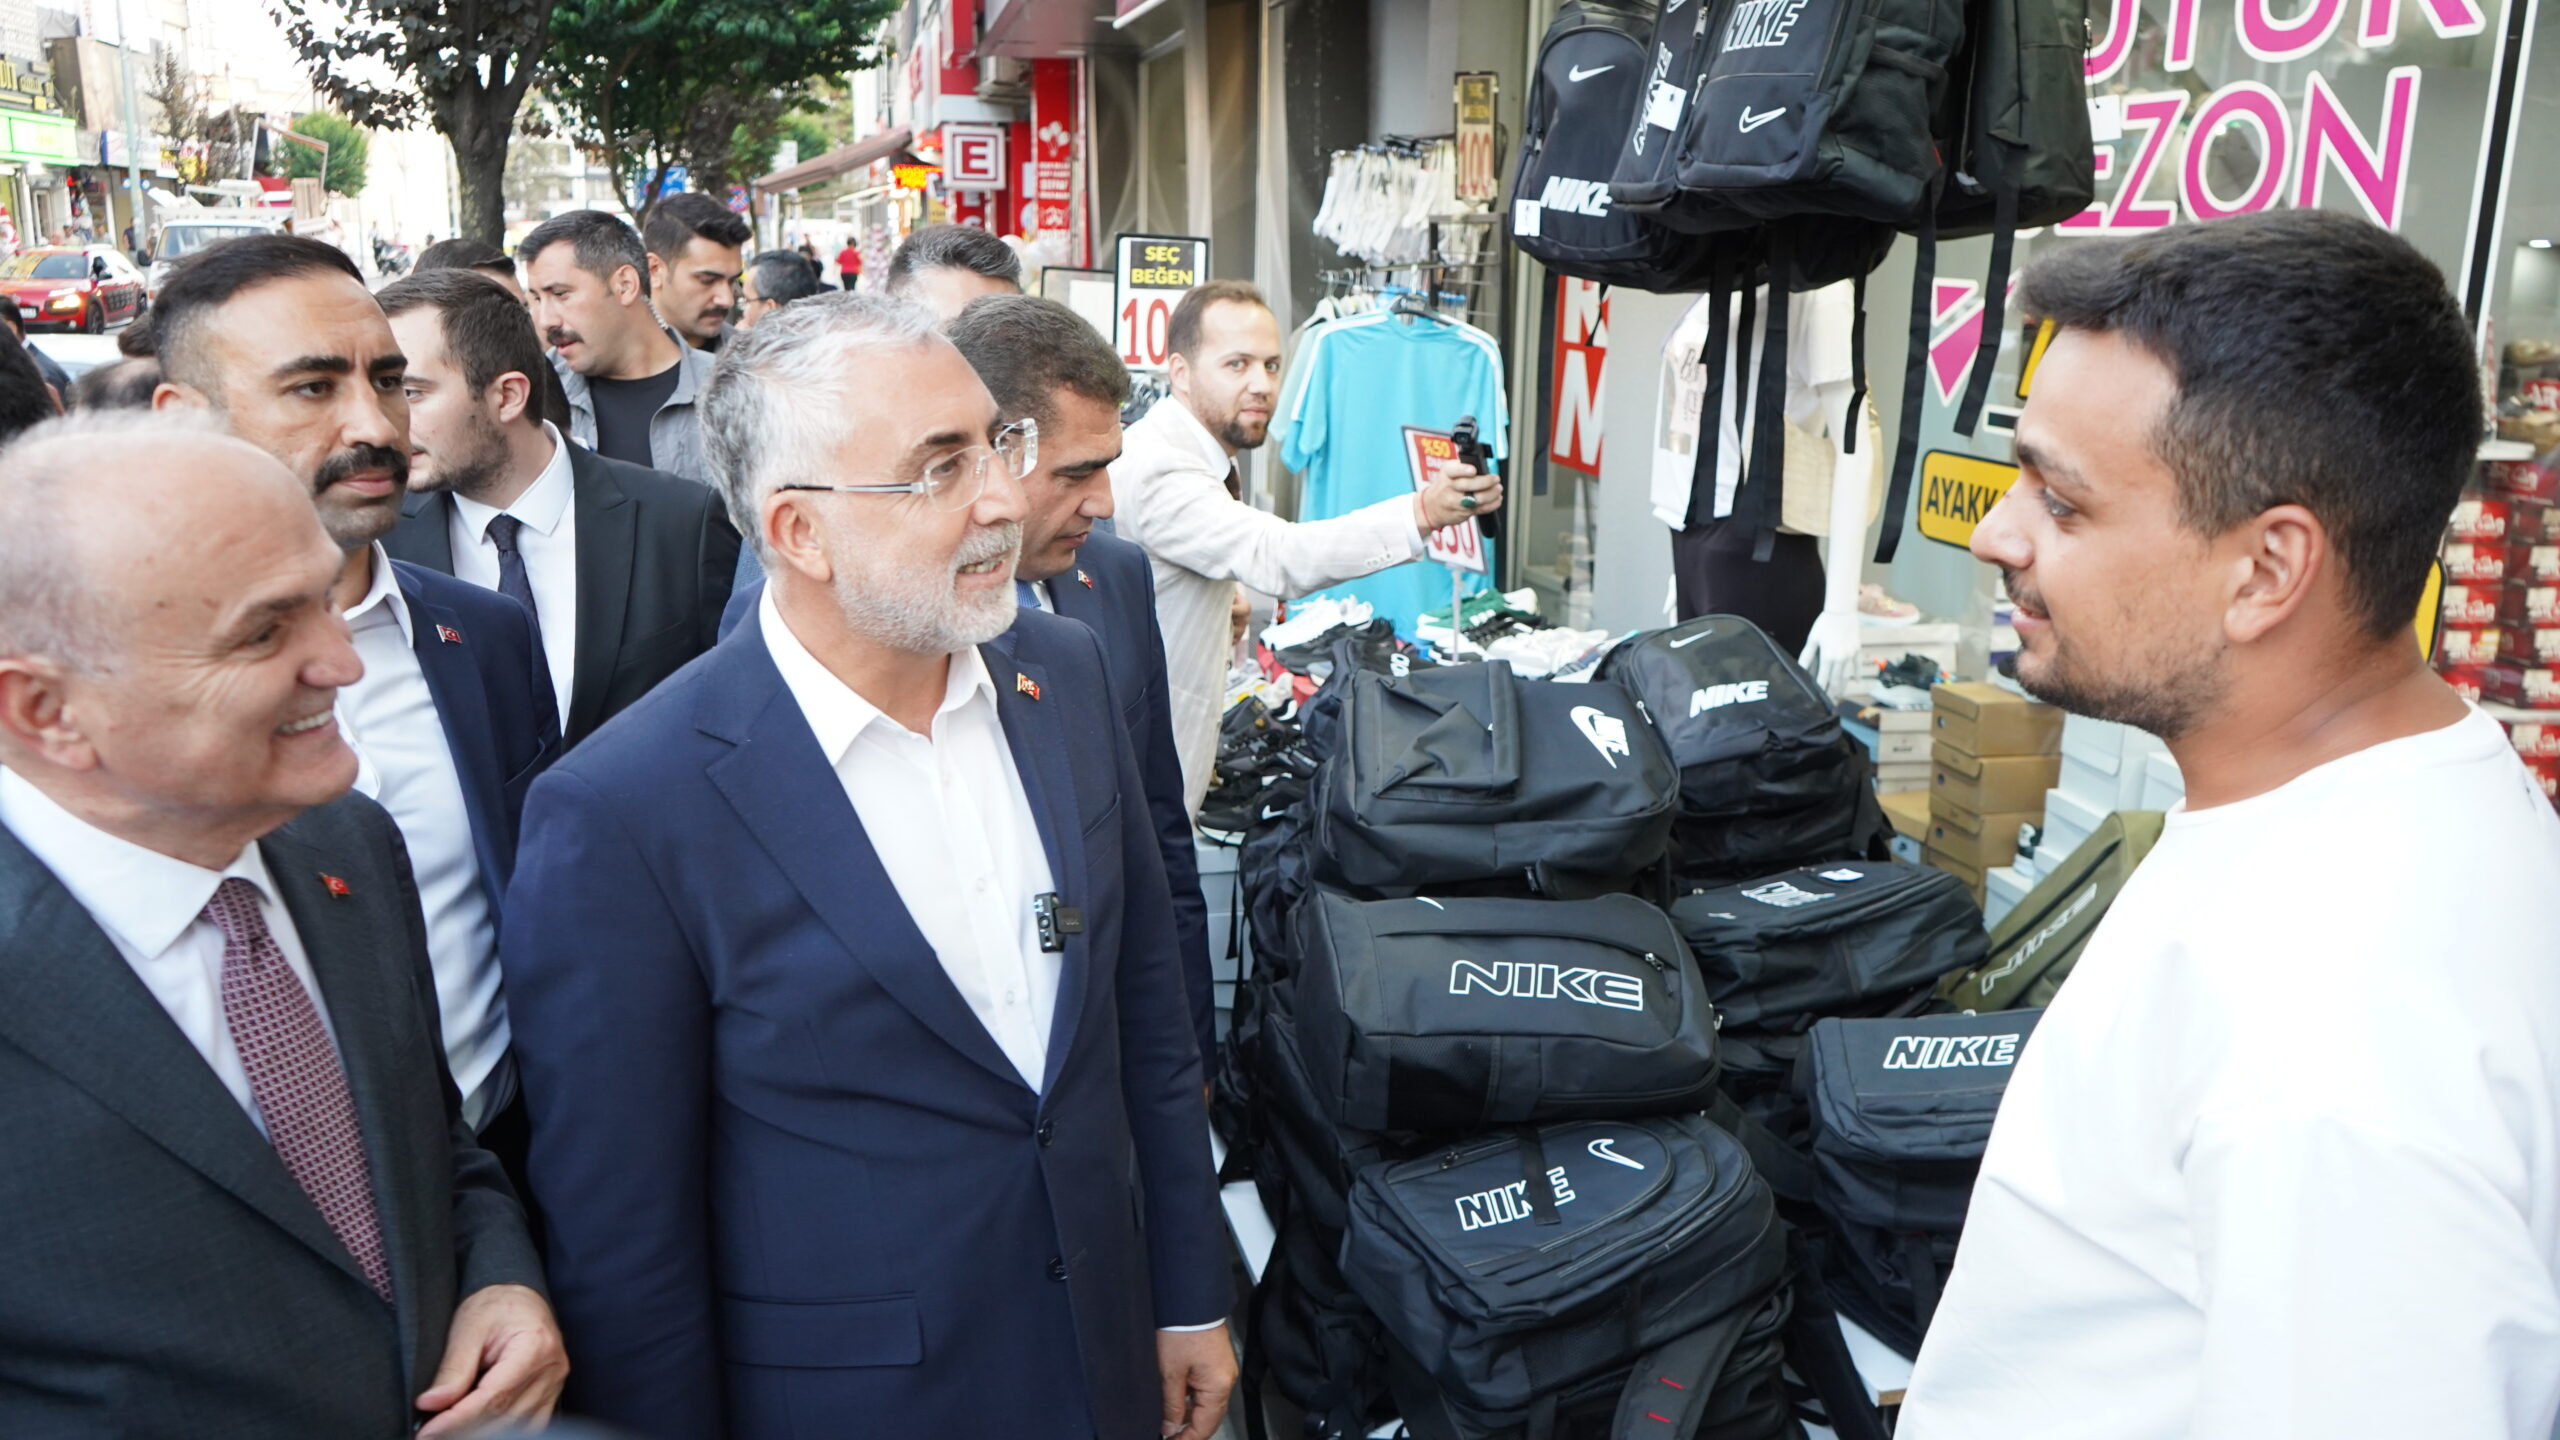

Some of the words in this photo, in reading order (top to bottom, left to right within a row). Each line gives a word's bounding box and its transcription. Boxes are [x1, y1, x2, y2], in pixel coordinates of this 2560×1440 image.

[1722, 0, 1808, 53] NIKE
[961, 140, 988, 174] E
[2035, 66, 2422, 238] ZON
[1540, 176, 1613, 217] NIKE
[1144, 246, 1181, 264] SEÇ
[1131, 266, 1193, 285] BEĞEN
[1925, 475, 2008, 524] AYAKK
[1690, 680, 1769, 718] NIKE
[1449, 959, 1644, 1011] NIKE
[1883, 1033, 2020, 1070] NIKE
